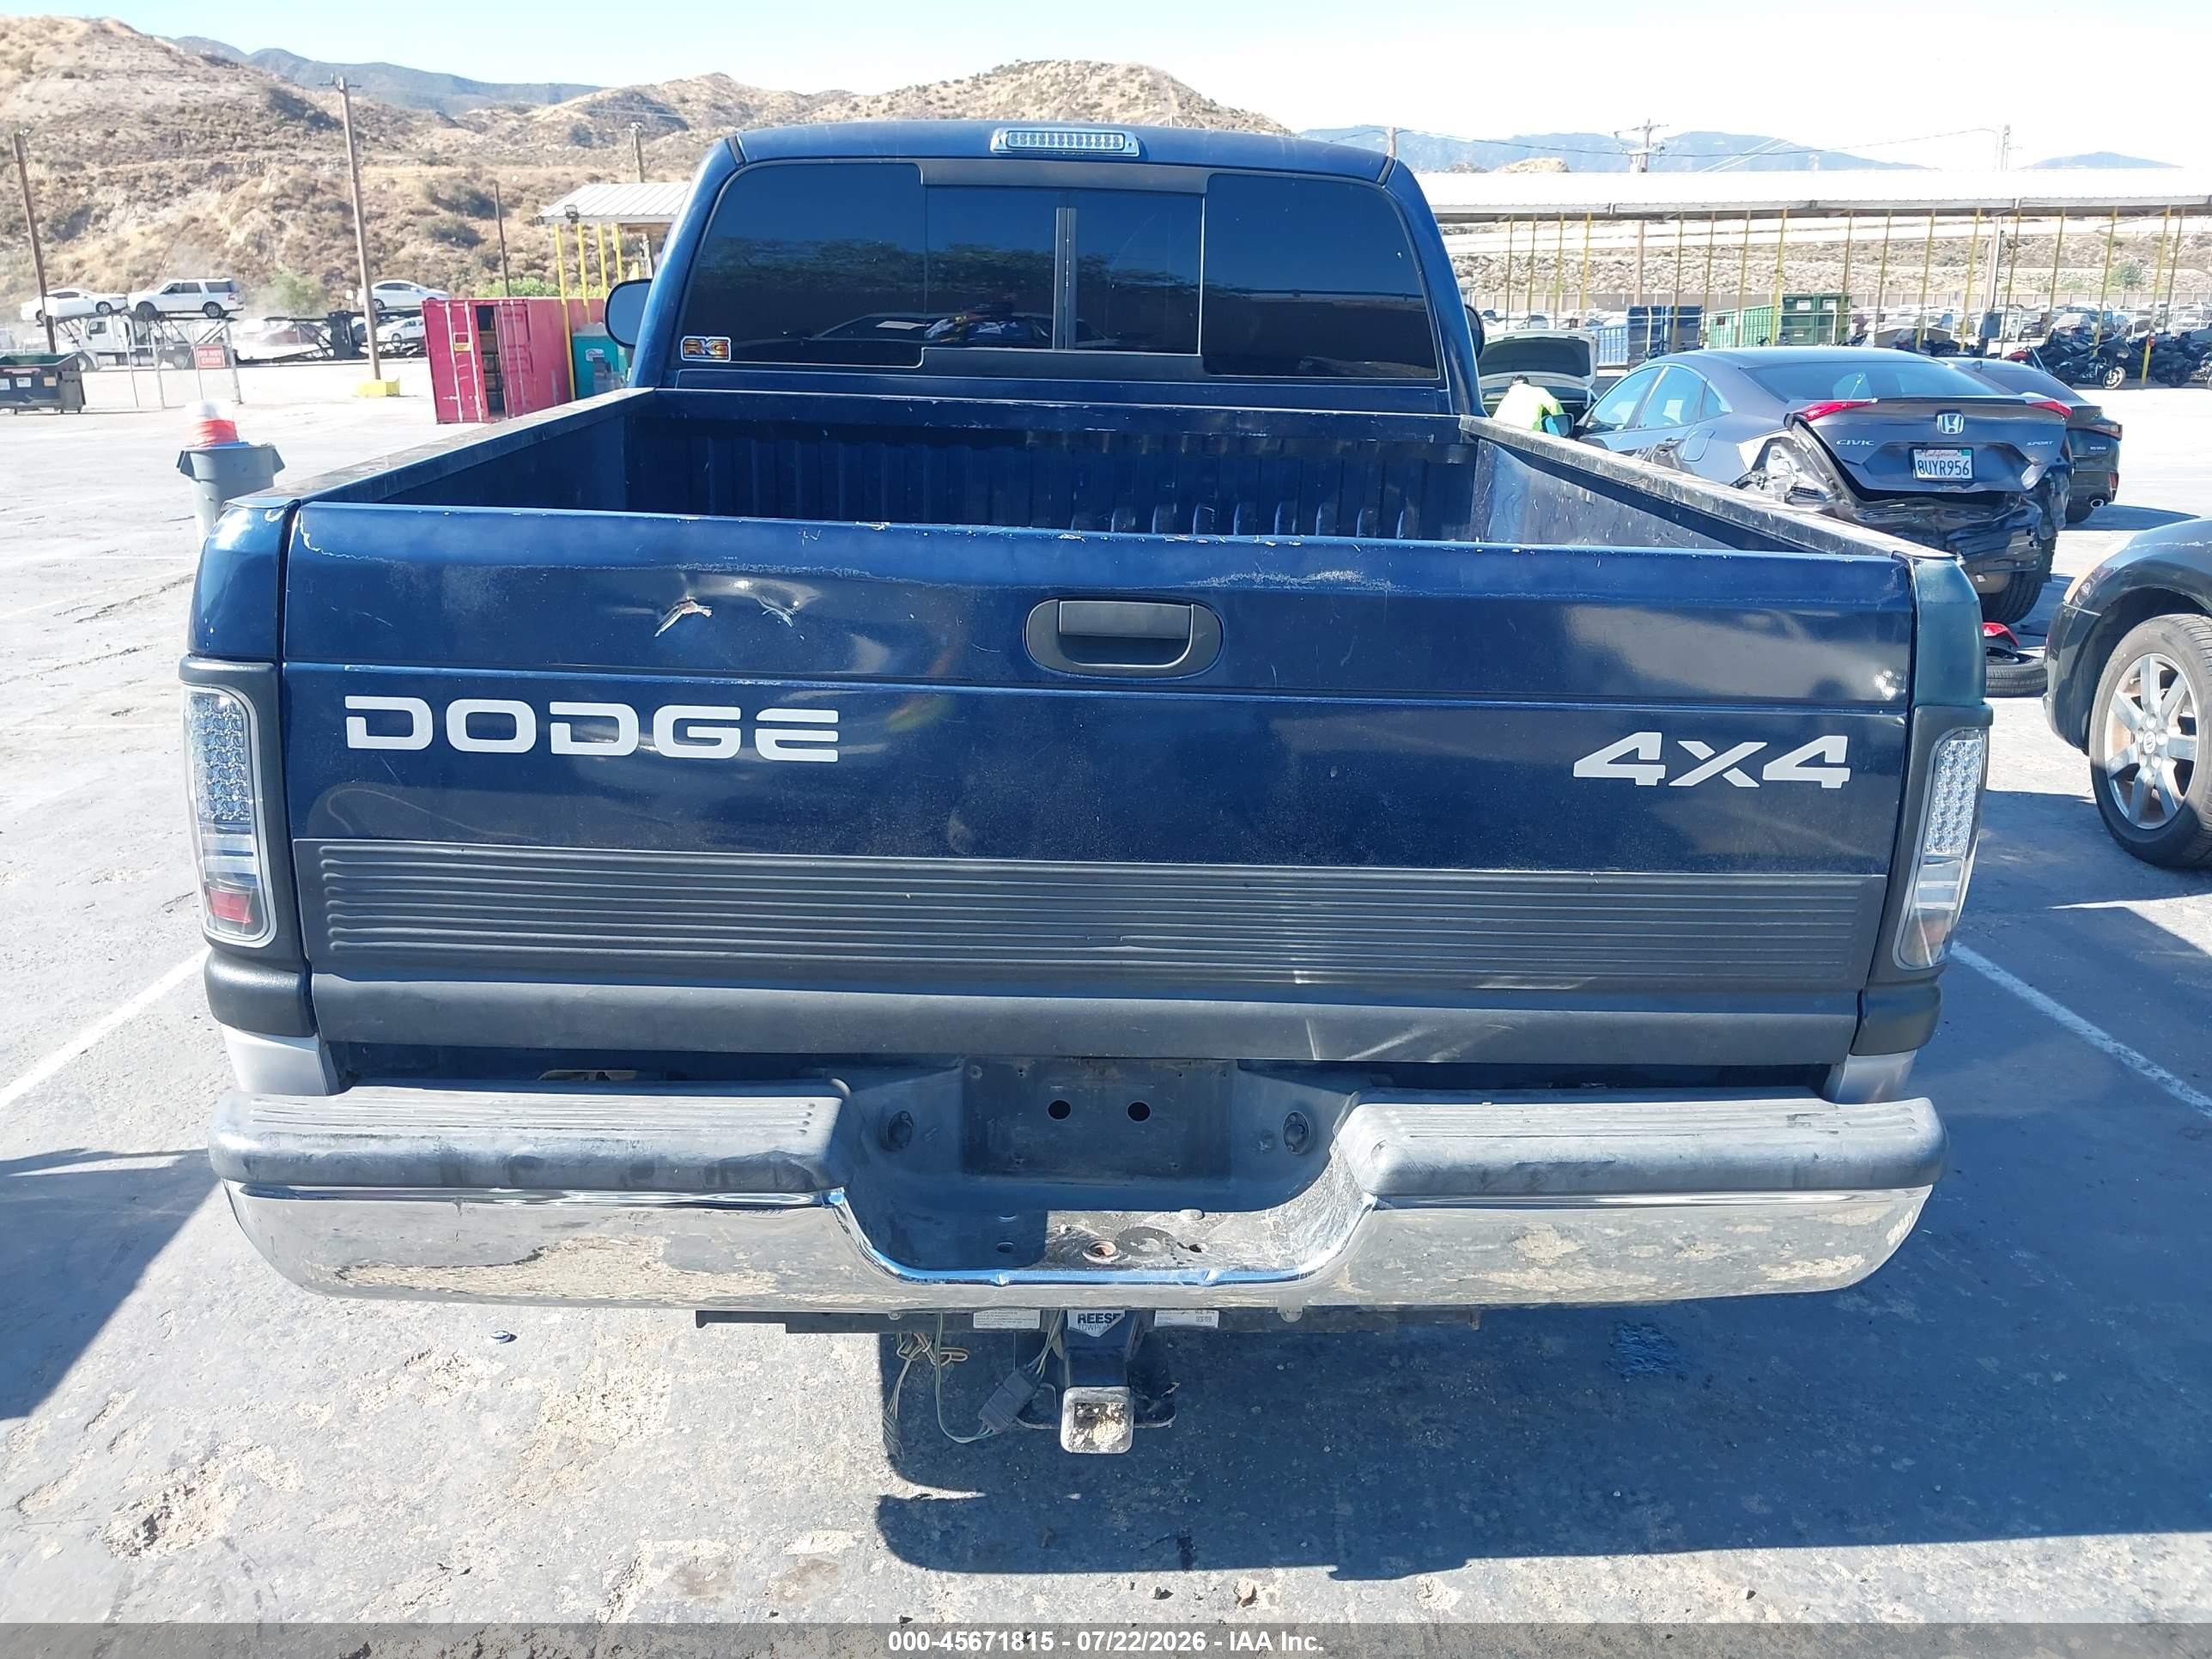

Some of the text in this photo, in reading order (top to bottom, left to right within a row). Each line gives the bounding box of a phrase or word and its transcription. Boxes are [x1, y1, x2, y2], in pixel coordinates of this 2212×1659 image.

[1923, 449, 1958, 459] California
[1917, 459, 1970, 476] 8UYR956
[345, 696, 839, 763] DODGE
